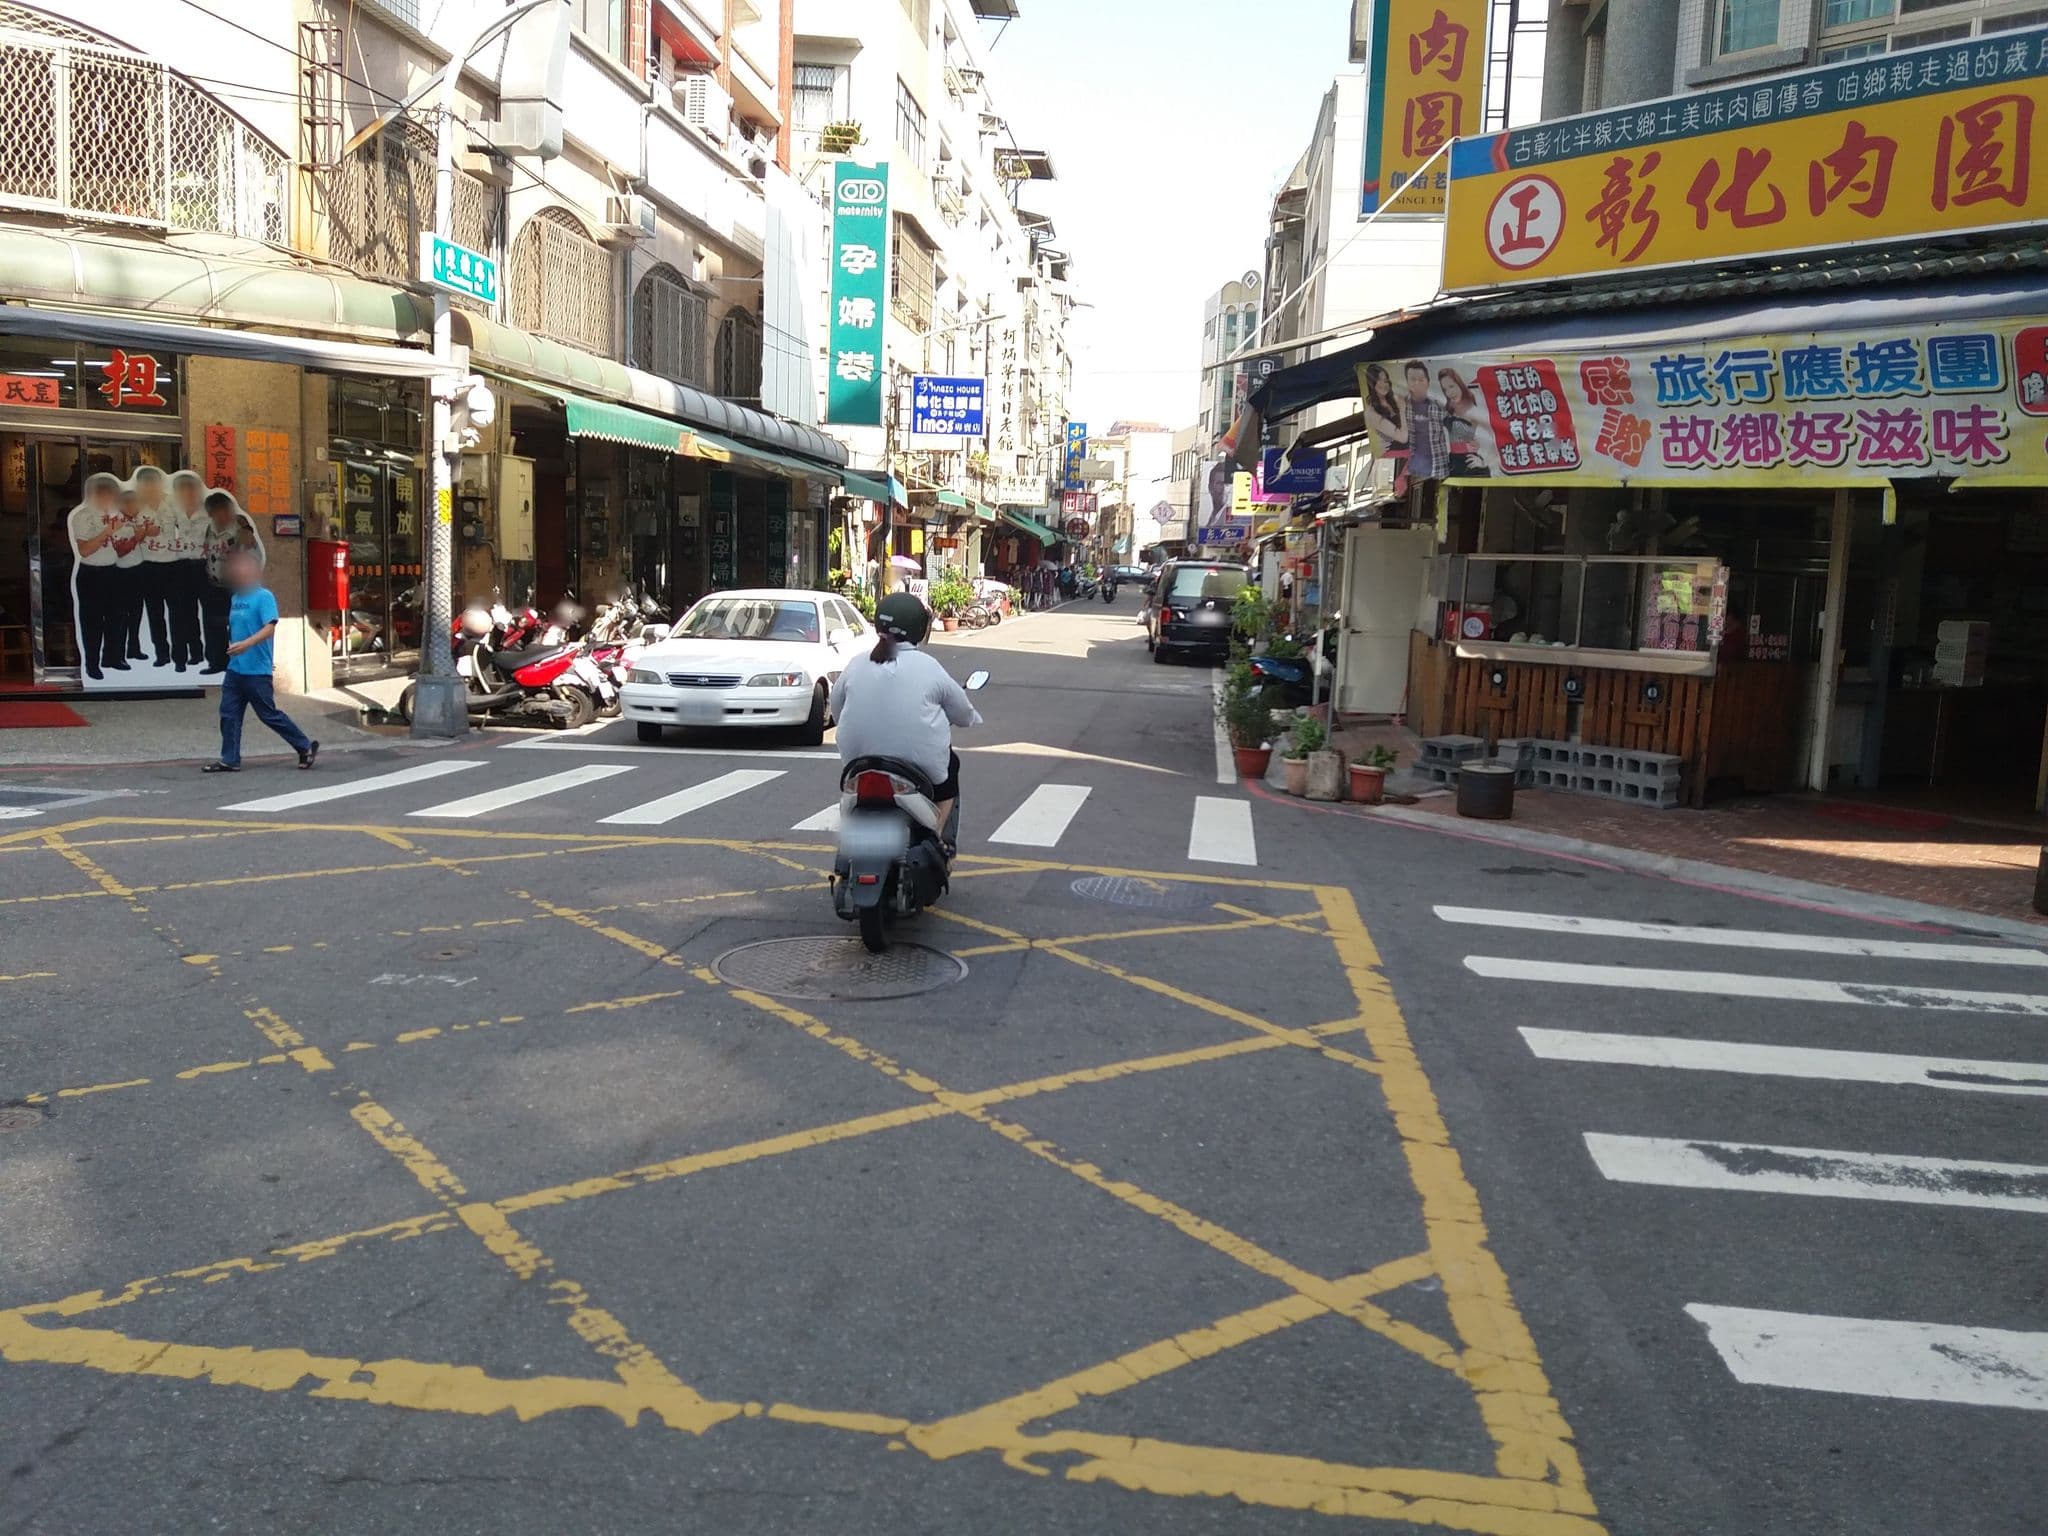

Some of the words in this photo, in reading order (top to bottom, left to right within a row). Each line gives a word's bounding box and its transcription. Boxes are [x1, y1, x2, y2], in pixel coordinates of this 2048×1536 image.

[837, 205, 884, 218] maternity
[837, 244, 878, 382] 孕婦裝
[956, 386, 980, 394] HOUSE
[1494, 365, 1542, 393] 真正的
[1651, 333, 2000, 405] 旅行應援團
[1659, 403, 2004, 467] 故鄉好滋味
[354, 473, 374, 535] 冷氣
[396, 476, 414, 536] 開放
